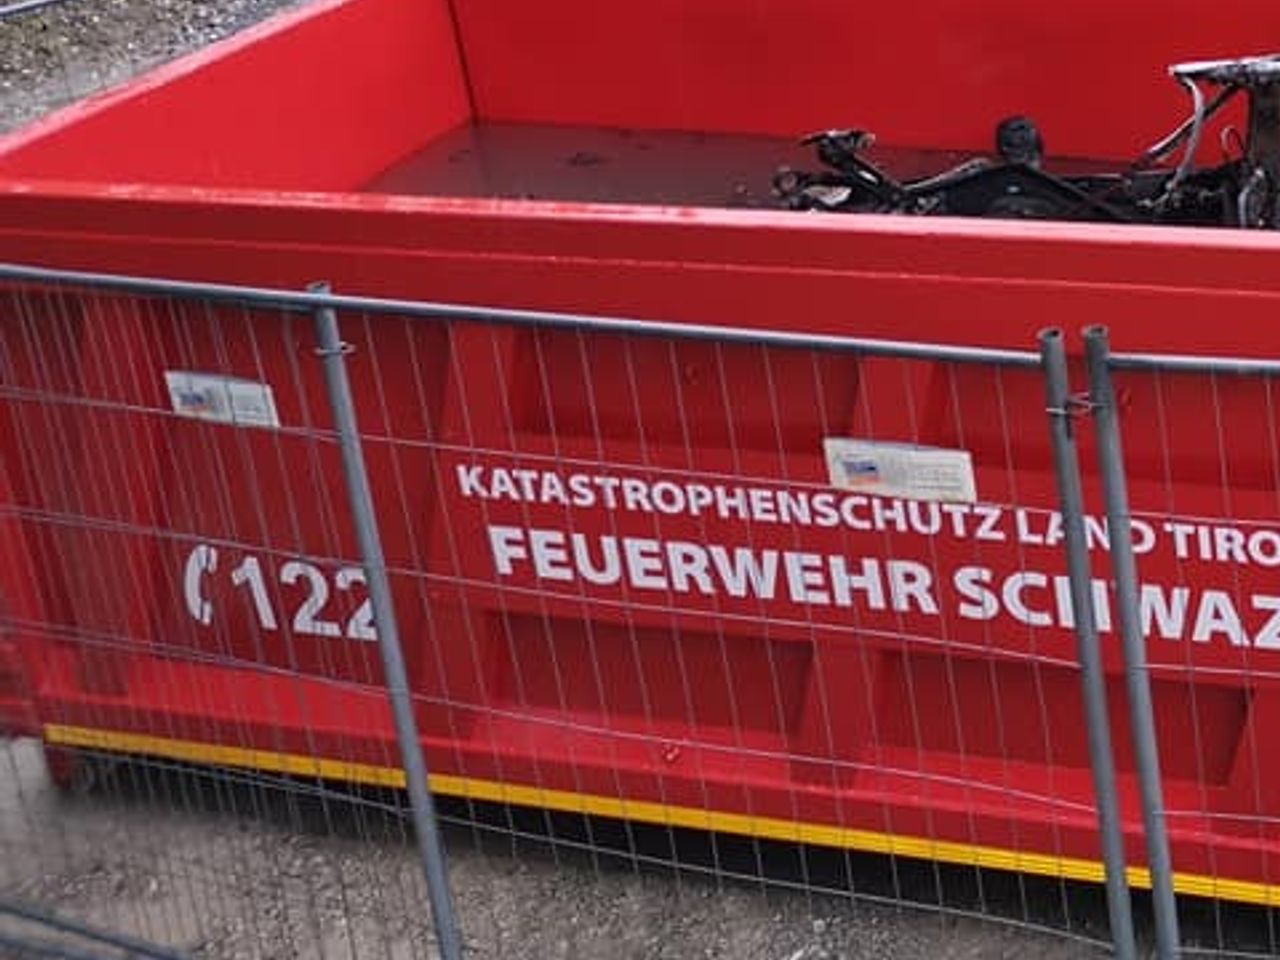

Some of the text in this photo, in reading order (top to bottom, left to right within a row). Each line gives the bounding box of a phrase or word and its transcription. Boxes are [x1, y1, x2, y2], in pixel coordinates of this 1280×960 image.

[457, 464, 1006, 542] KATASTROPHENSCHUTZ
[231, 555, 379, 642] 122
[487, 524, 940, 618] FEUERWEHR
